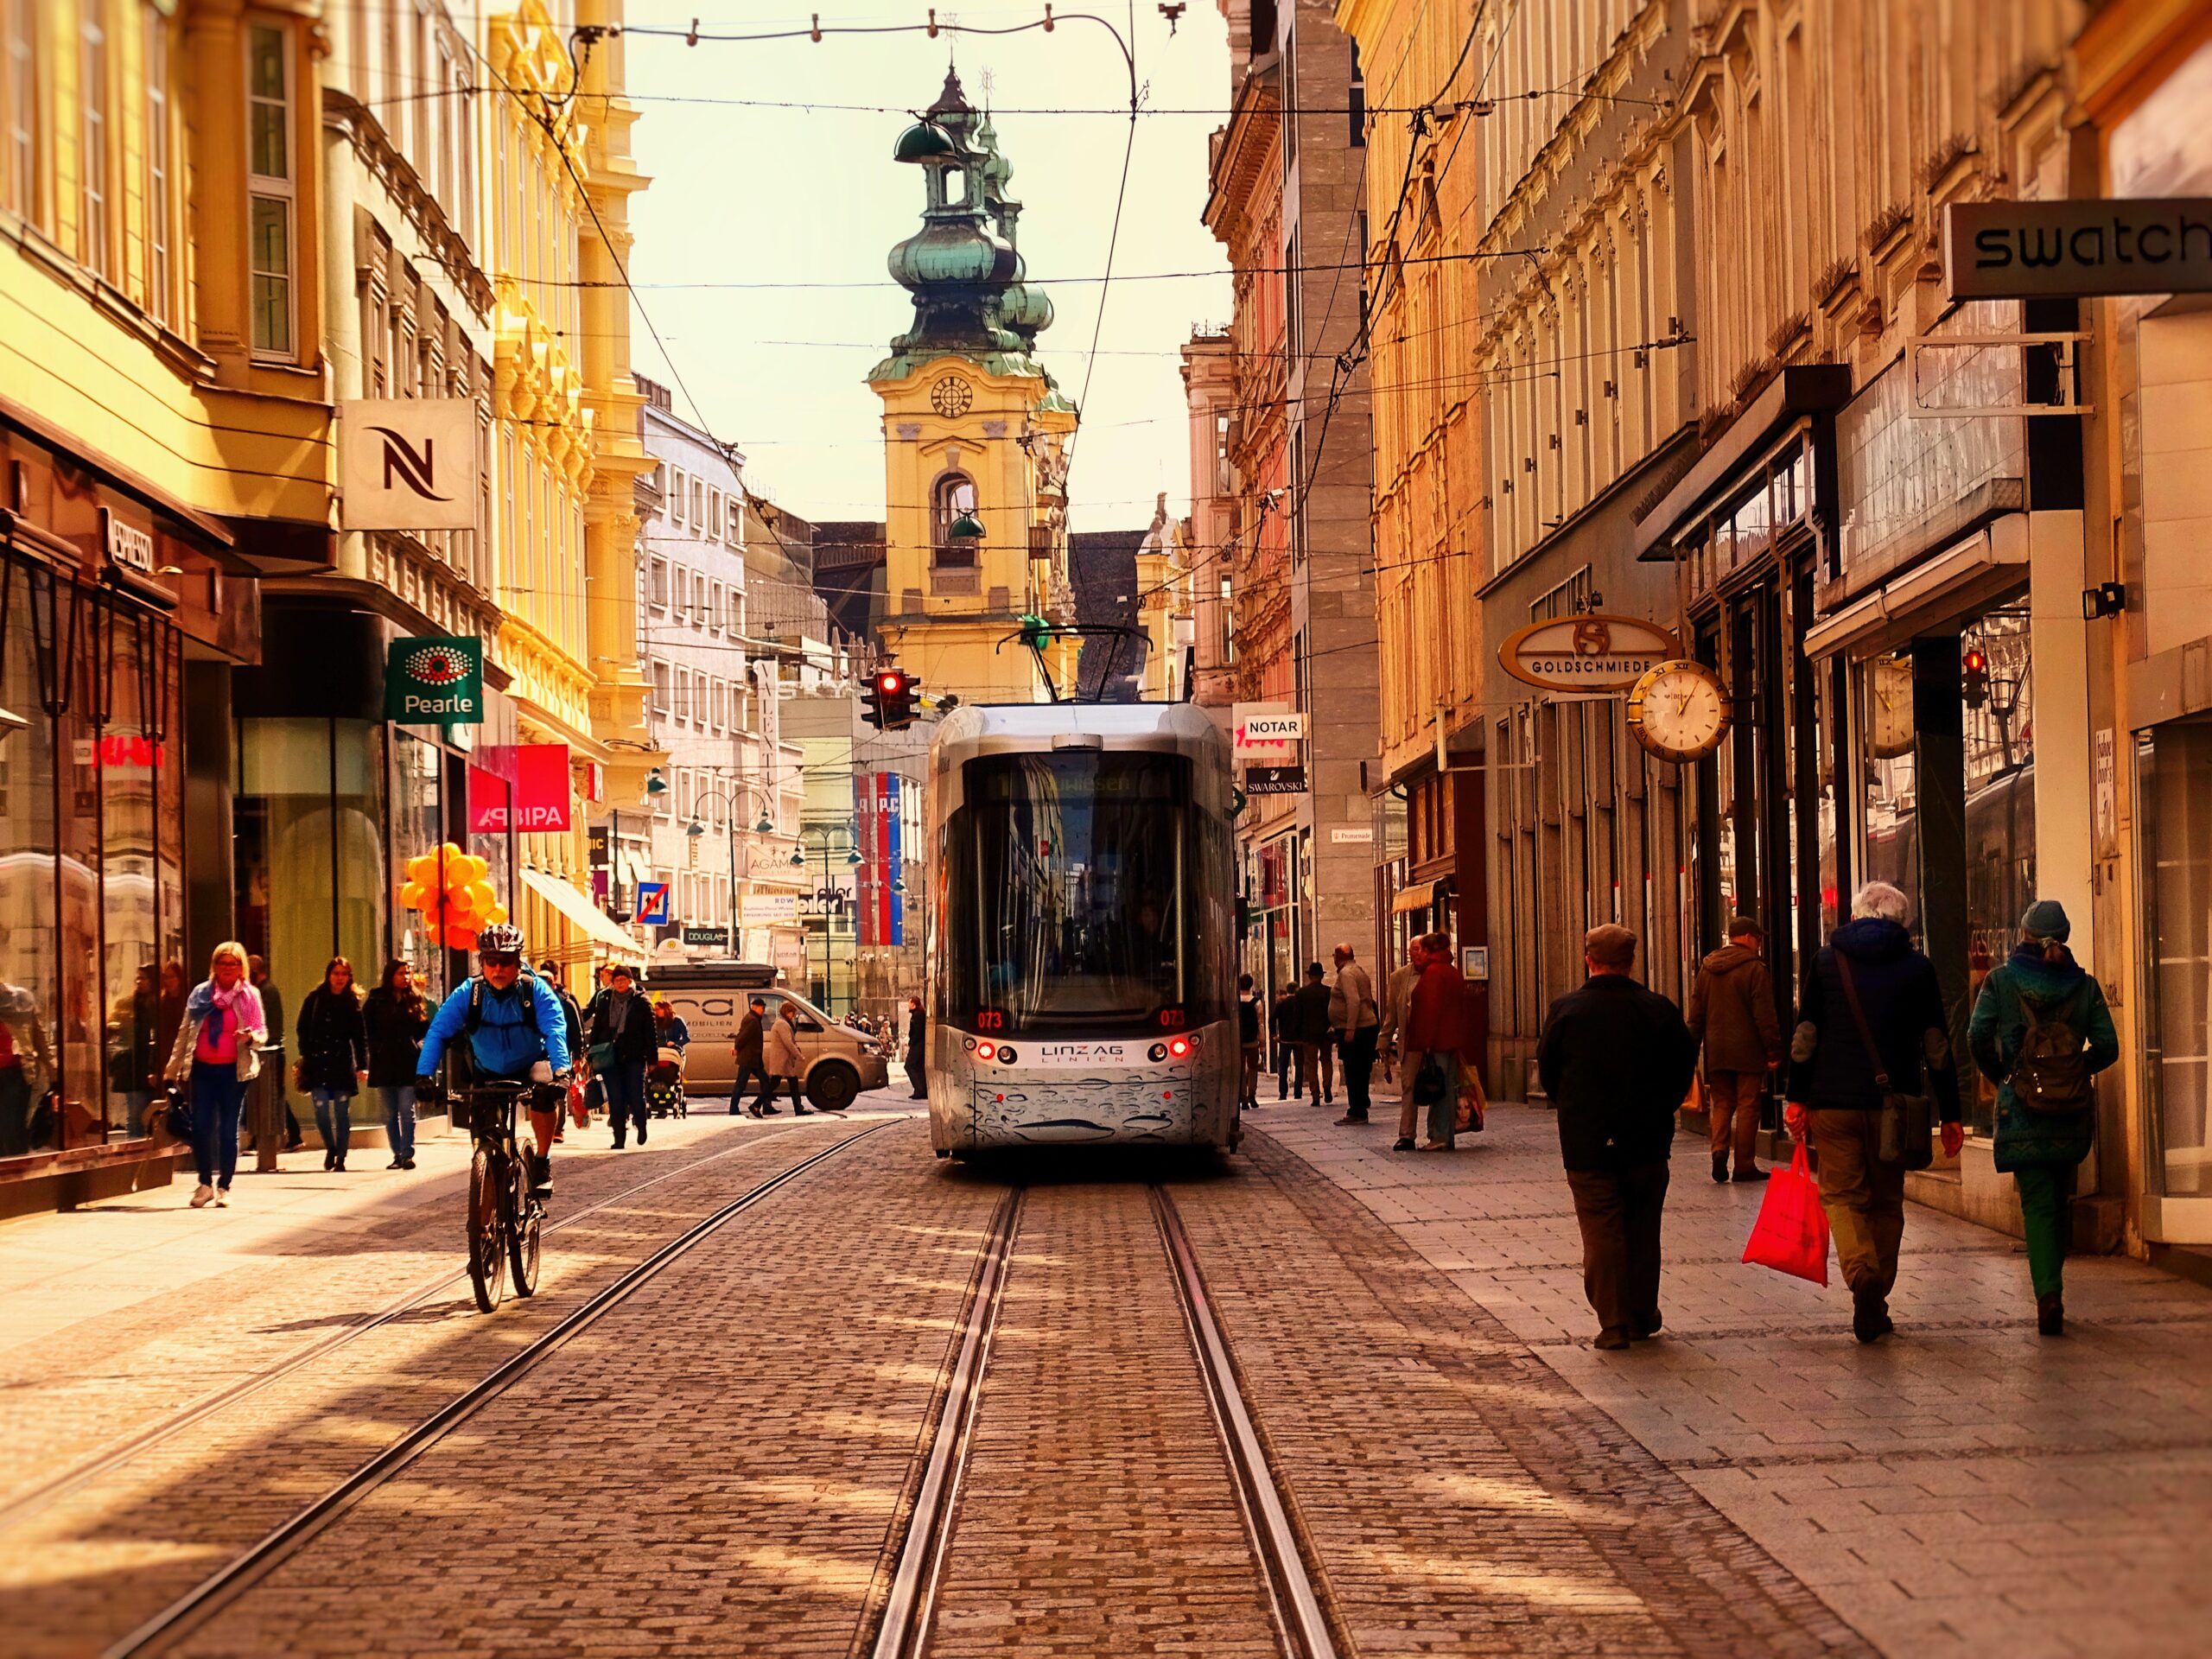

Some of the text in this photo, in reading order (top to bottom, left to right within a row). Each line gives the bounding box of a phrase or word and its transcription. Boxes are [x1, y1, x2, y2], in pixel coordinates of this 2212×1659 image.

[1975, 216, 2212, 269] swatch
[98, 505, 153, 573] NESPRESSO
[1532, 661, 1650, 673] GOLDSCHMIEDE
[405, 695, 474, 714] Pearle
[1249, 721, 1298, 733] NOTAR
[1248, 782, 1302, 792] SWAROVSKI
[751, 859, 792, 869] AGAM
[978, 1011, 1002, 1028] 073
[1160, 1009, 1185, 1027] 073
[1041, 1046, 1123, 1056] LINZ AG
